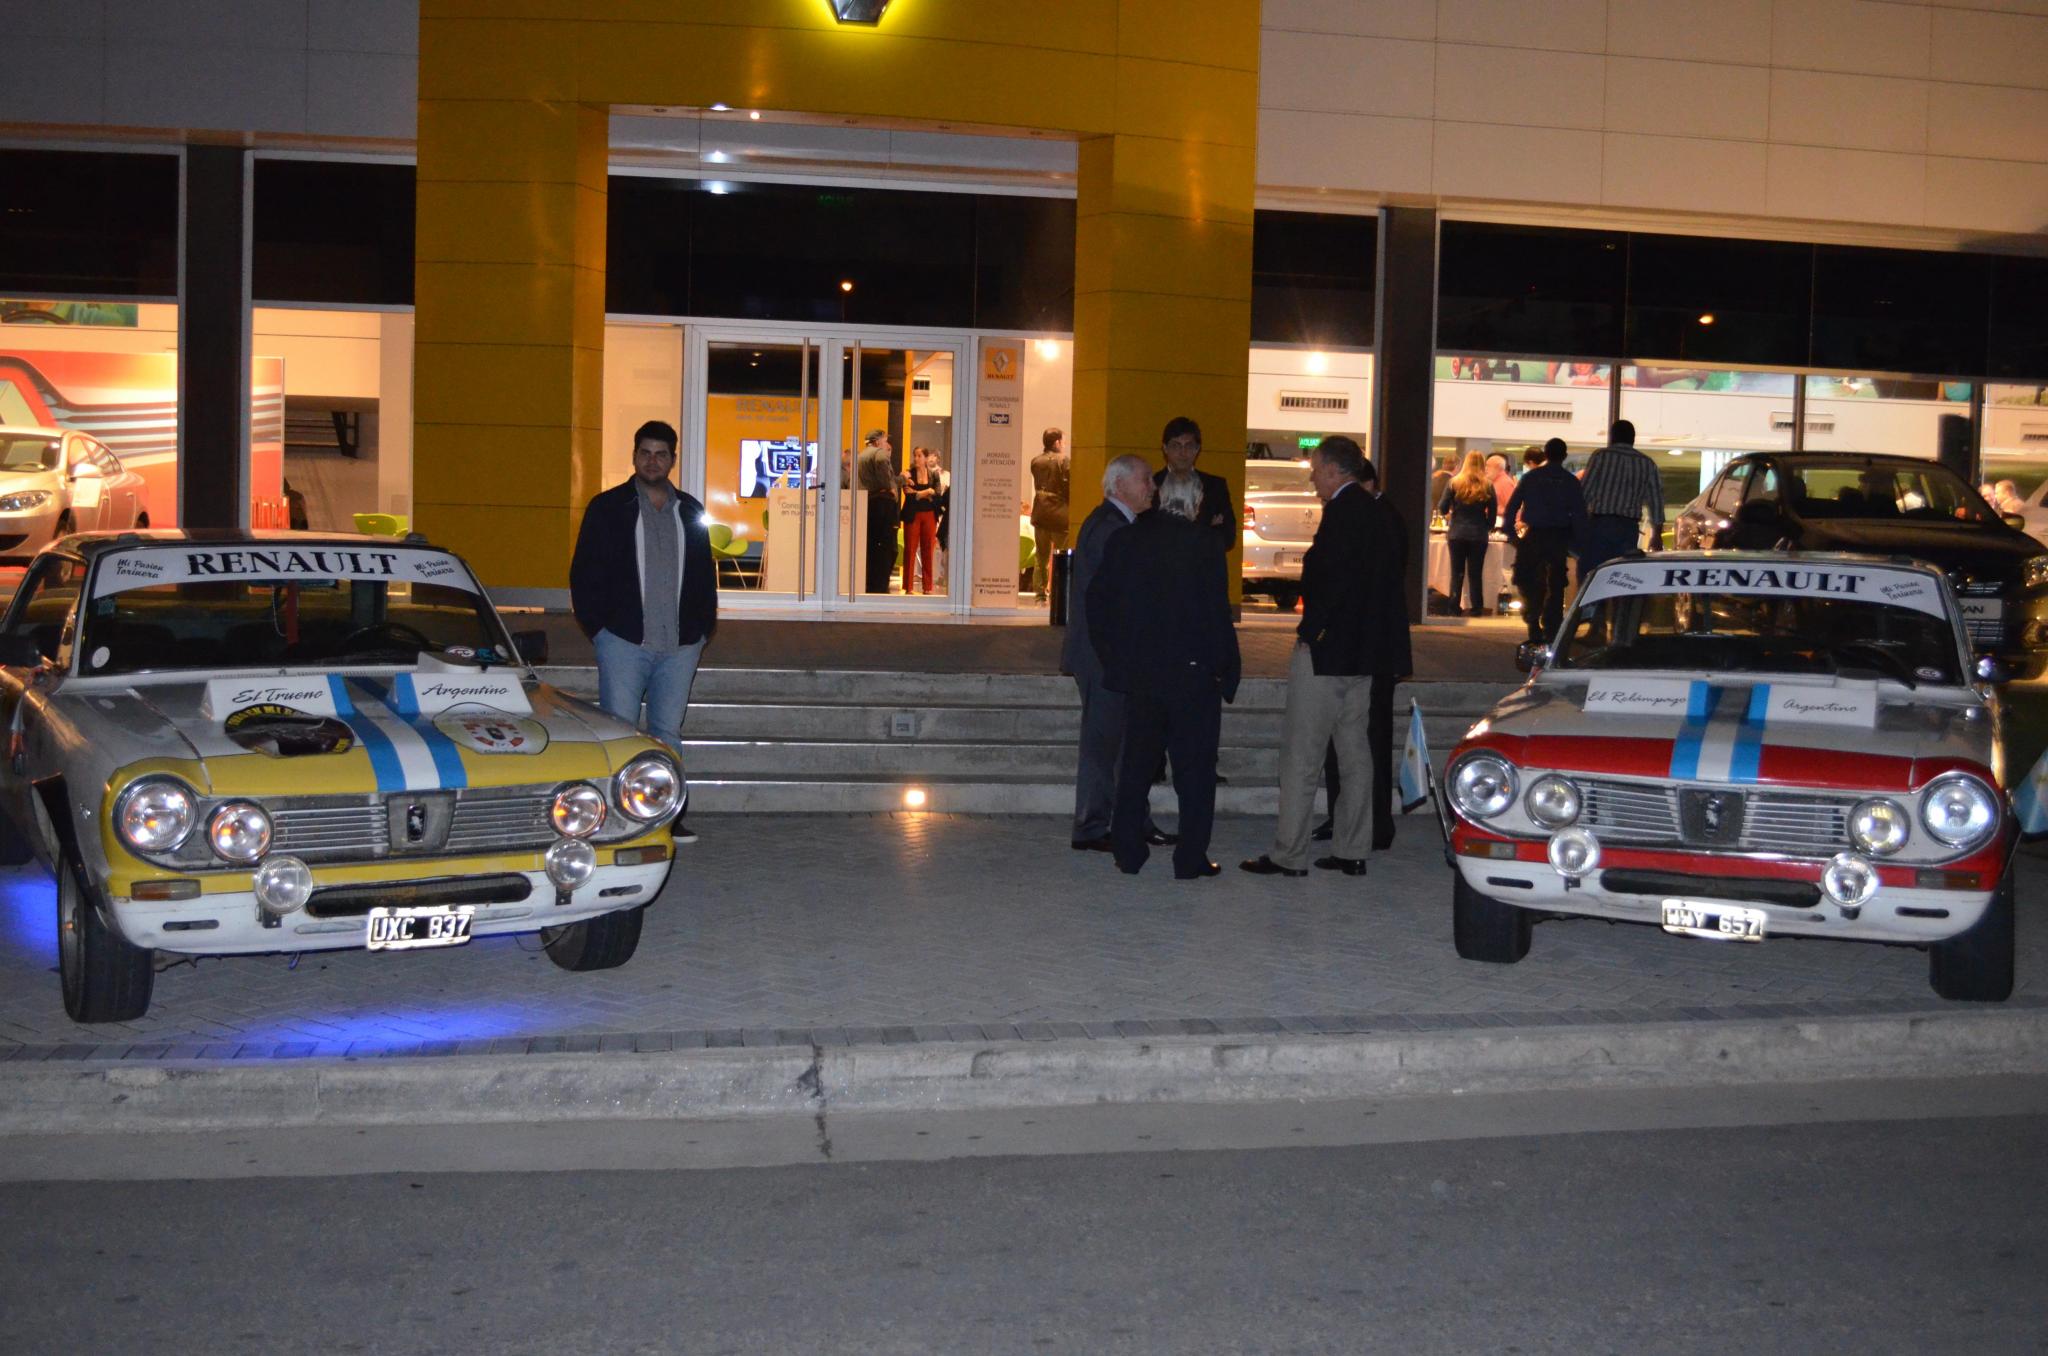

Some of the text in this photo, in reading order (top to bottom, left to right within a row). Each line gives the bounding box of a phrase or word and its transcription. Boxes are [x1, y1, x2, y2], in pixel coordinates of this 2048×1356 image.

[187, 551, 398, 576] RENAULT
[1660, 568, 1866, 594] RENAULT
[232, 687, 325, 703] El Trueno
[422, 683, 509, 699] Argentino
[1587, 689, 1607, 702] El
[1783, 698, 1858, 714] Argentino
[373, 913, 471, 941] UXC 837
[1718, 914, 1761, 936] 657
